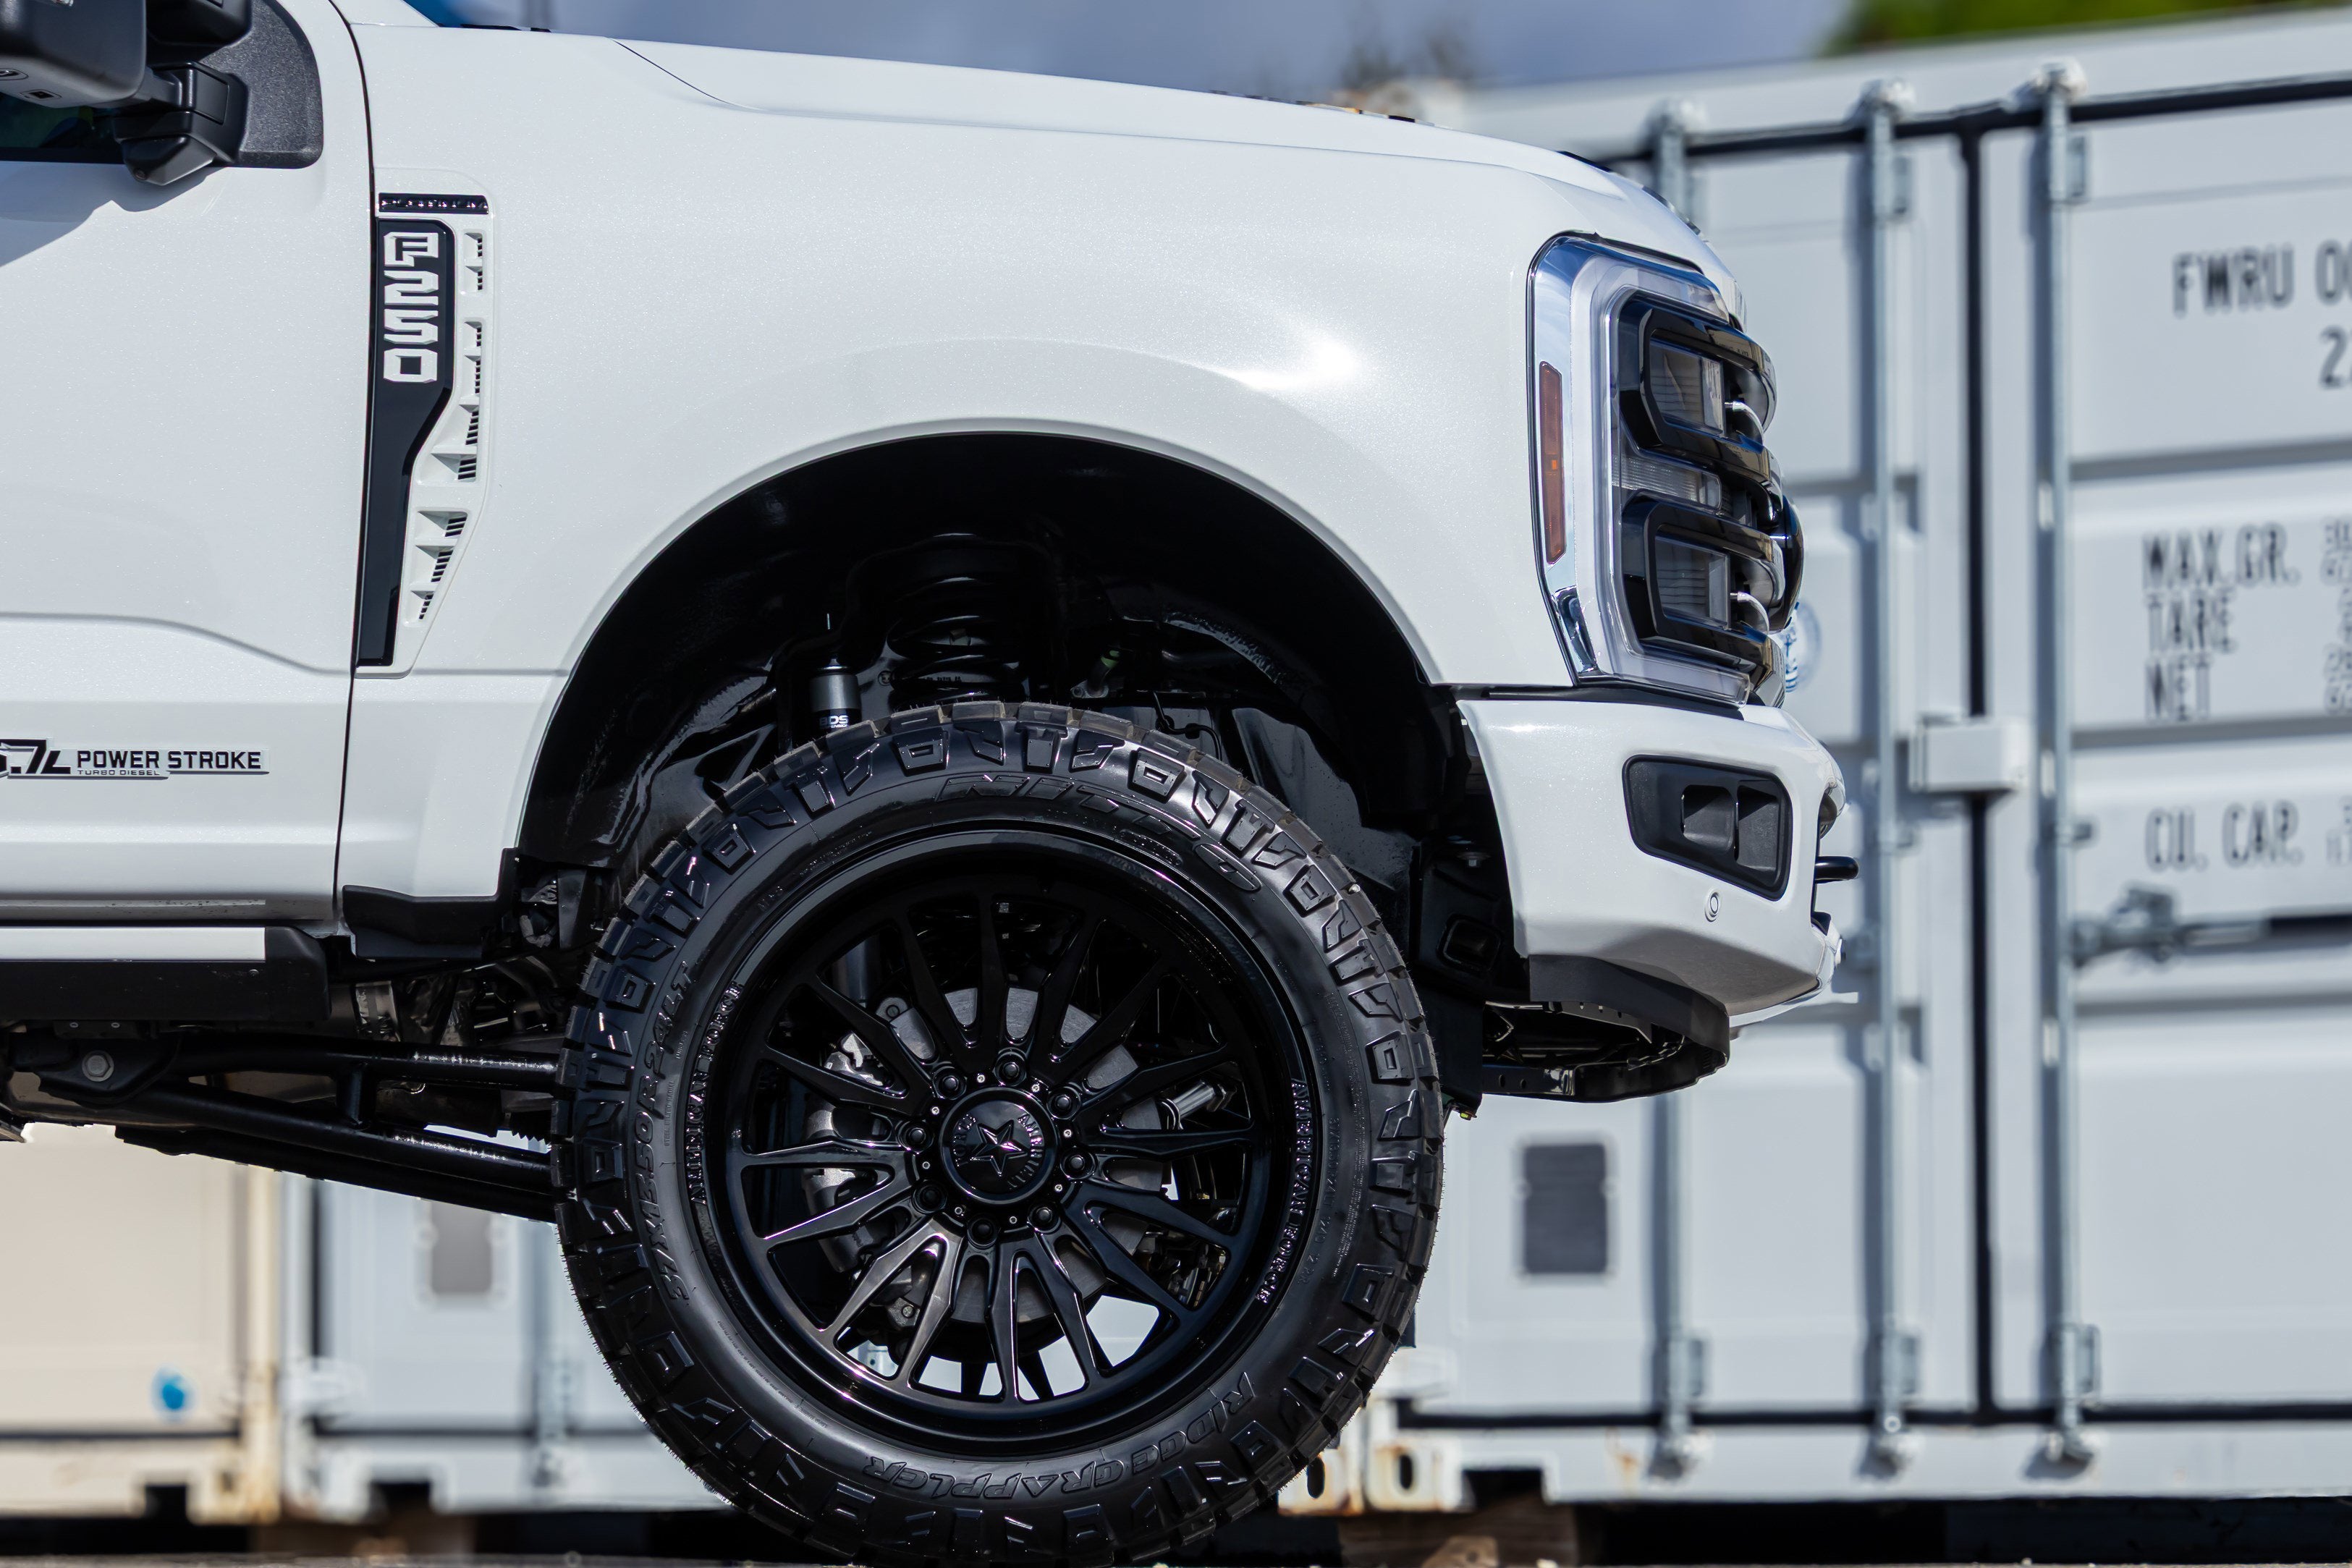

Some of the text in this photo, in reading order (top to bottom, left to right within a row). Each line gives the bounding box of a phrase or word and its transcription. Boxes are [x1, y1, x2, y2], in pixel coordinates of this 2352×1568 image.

[384, 232, 439, 383] F250
[2172, 239, 2352, 318] FWRU 0
[2319, 325, 2352, 391] 2
[77, 750, 160, 769] POWER
[168, 750, 261, 769] STROKE
[862, 1370, 1257, 1501] RIDGE GRAPPLER
